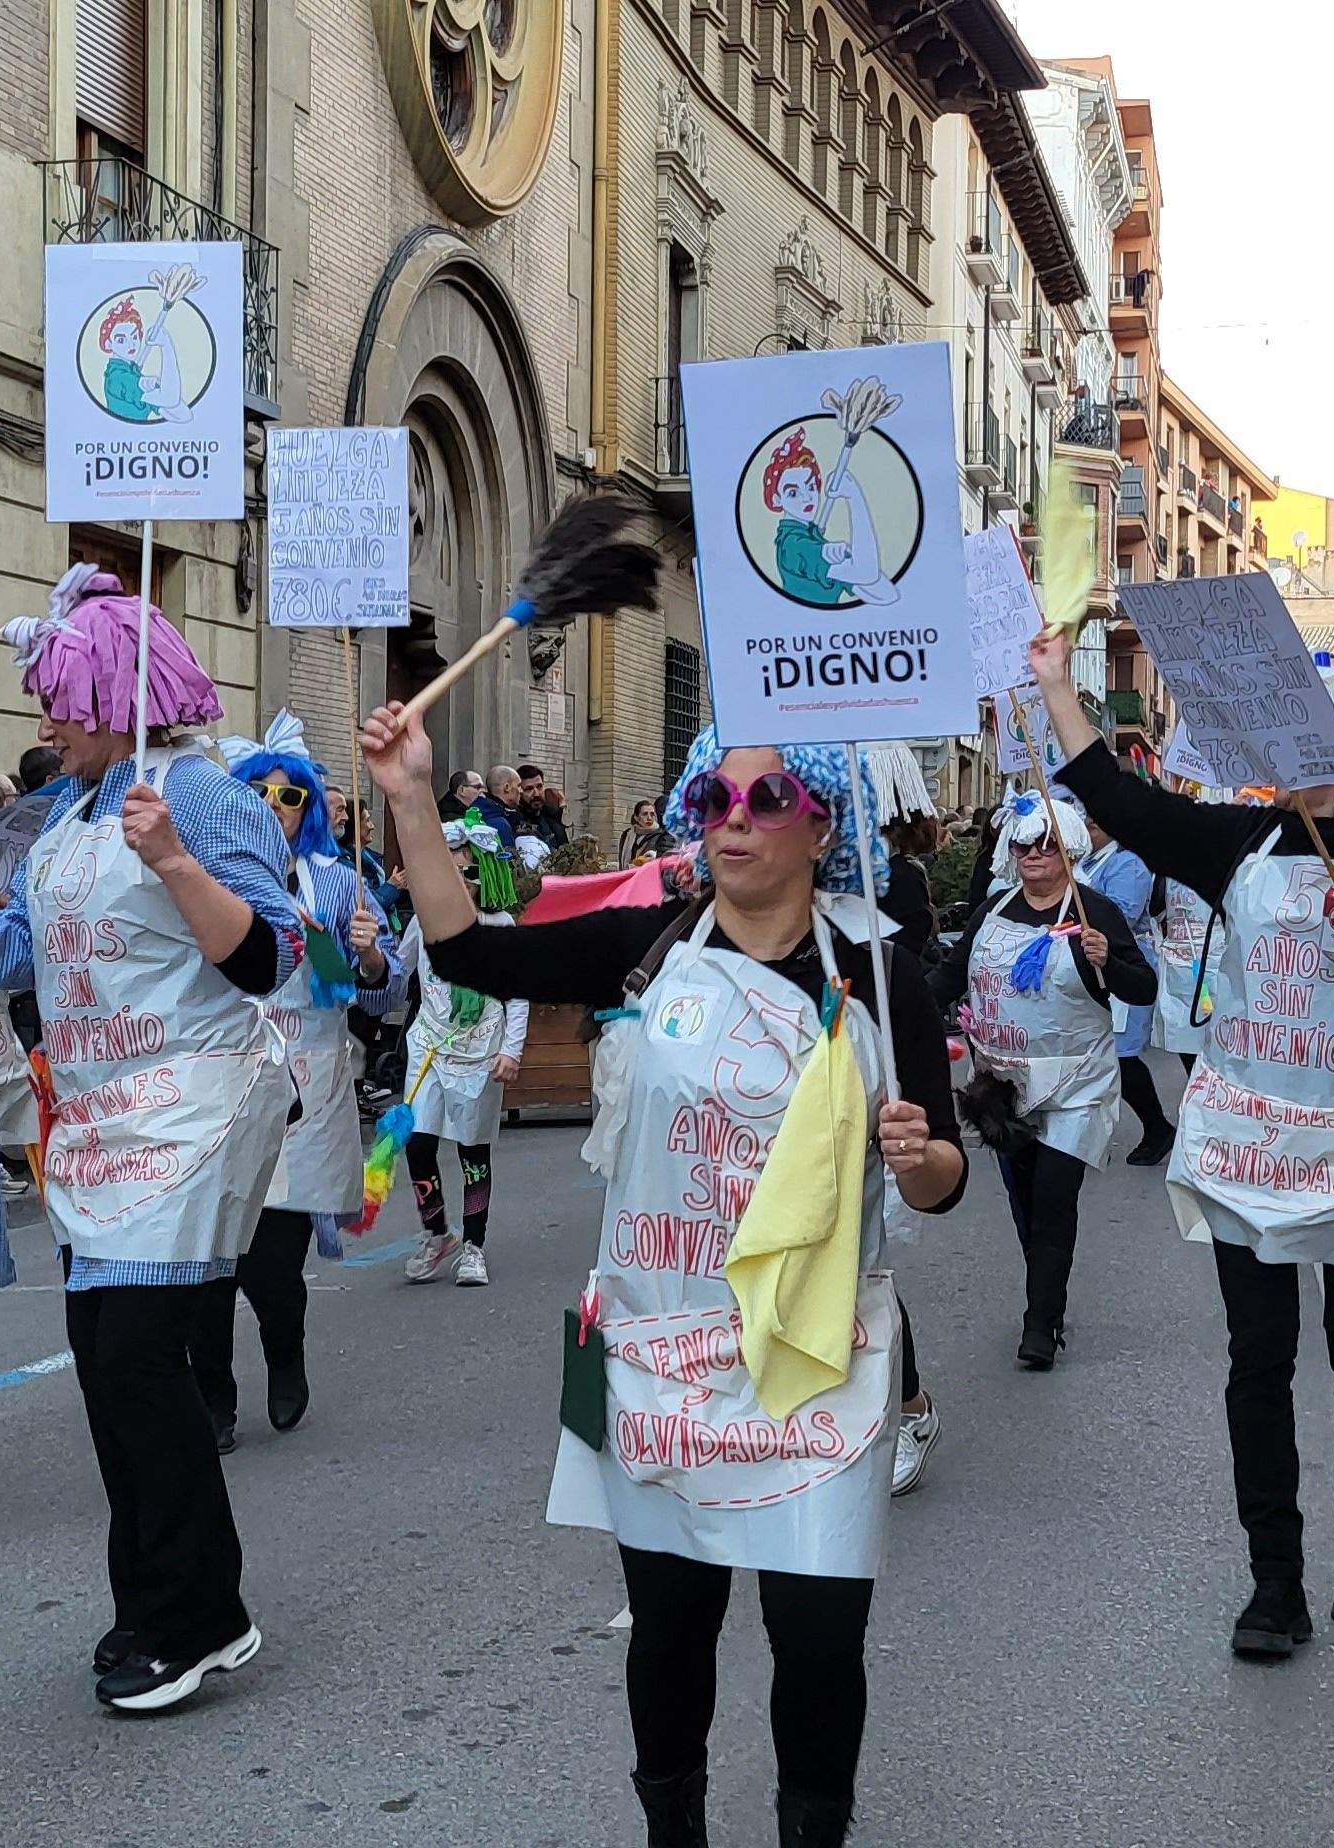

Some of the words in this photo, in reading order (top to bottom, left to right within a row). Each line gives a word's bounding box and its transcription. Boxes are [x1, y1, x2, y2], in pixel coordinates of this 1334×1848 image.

[75, 442, 105, 455] POR
[110, 441, 133, 454] UN
[137, 441, 219, 453] CONVENIO
[272, 430, 389, 469] HUELGA
[85, 455, 209, 486] ¡DIGNO!
[272, 467, 386, 503] LIMPIEZA
[294, 502, 355, 537] AÑOS
[271, 538, 385, 569] CONVENIO
[1120, 578, 1266, 626] HUELGA
[746, 636, 787, 655] POR
[792, 634, 822, 651] UN
[829, 628, 938, 650] CONVENIO
[1141, 619, 1278, 664] LIMPIEZA
[762, 648, 927, 697] ¡DIGNO!
[1163, 667, 1191, 698] 5
[1191, 660, 1258, 698] AÑOS
[1181, 692, 1309, 732] CONVENIO
[53, 824, 115, 910] 5
[1275, 863, 1334, 933] 5
[45, 914, 127, 963] AÑOS
[982, 924, 1027, 968] 5
[713, 987, 807, 1120] 5
[49, 1144, 179, 1187] OLVIDADAS
[609, 1210, 736, 1281] CONVE
[616, 1406, 844, 1469] OLVIDADAS
